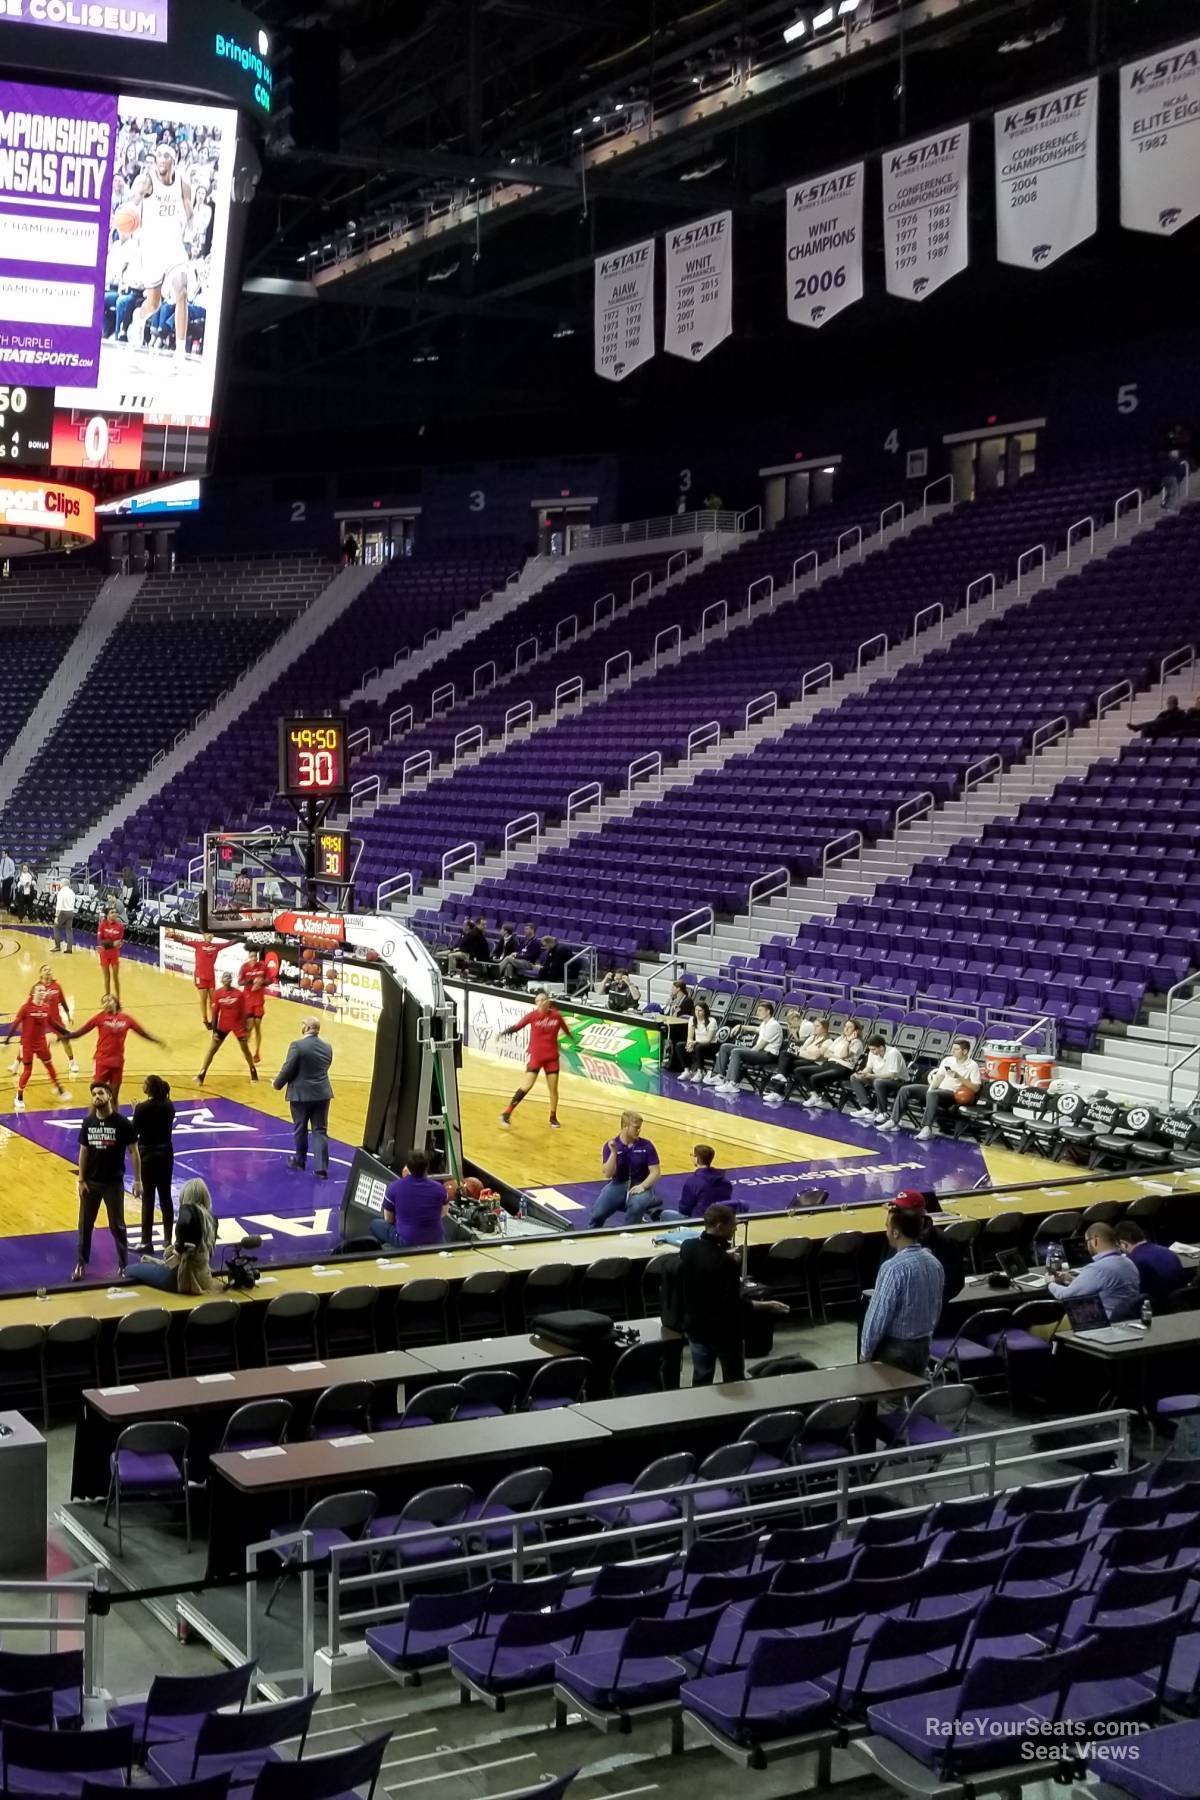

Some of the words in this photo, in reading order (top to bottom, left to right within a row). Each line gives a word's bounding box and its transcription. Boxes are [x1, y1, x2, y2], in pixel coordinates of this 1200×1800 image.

[30, 1, 156, 35] COLISEUM
[216, 33, 263, 79] Bringing
[1130, 50, 1200, 89] K-STA
[1004, 88, 1089, 133] K-STATE
[1133, 110, 1171, 134] ELITE
[1174, 100, 1200, 121] EIG
[890, 134, 961, 174] K-STATE
[1012, 131, 1080, 161] CONFERENCE
[1138, 134, 1168, 153] 1982
[1001, 138, 1087, 176] CHAMPIONSHIPS
[60, 154, 107, 199] CITY
[897, 172, 953, 199] CONFERENCE
[1011, 175, 1038, 194] 2004
[793, 171, 857, 207] K-STATE
[887, 181, 959, 213] CHAMPIONSHIPS
[1011, 191, 1038, 208] 2008
[928, 203, 951, 218] 1982
[672, 218, 727, 250] K-STATE
[808, 217, 839, 238] WNIT
[896, 227, 918, 242] 1977
[788, 226, 856, 261] CHAMPIONS
[927, 230, 950, 247] 1984
[600, 246, 650, 276] K-STATE
[686, 254, 712, 273] WNIT
[895, 255, 917, 271] 1979
[927, 245, 949, 261] 1987
[612, 280, 637, 298] AIAW
[701, 278, 719, 291] 2015
[794, 265, 846, 300] 2006
[677, 309, 695, 322] 2007
[1117, 383, 1138, 413] 5
[11, 432, 19, 443] 4
[28, 441, 49, 450] BONUS
[85, 416, 109, 461] 0
[883, 429, 899, 454] 4
[11, 446, 19, 458] 0
[679, 468, 692, 491] 3
[469, 490, 485, 511] 3
[291, 502, 306, 522] 2
[291, 729, 337, 749] 49:50
[298, 751, 333, 787] 30
[325, 854, 340, 873] 30
[1016, 1097, 1043, 1108] Federal
[1019, 1089, 1046, 1101] Capitol
[1087, 1110, 1113, 1123] Federal
[1091, 1102, 1117, 1115] Capitol
[1160, 1123, 1188, 1139] Federal
[1164, 1116, 1193, 1131] Capitol
